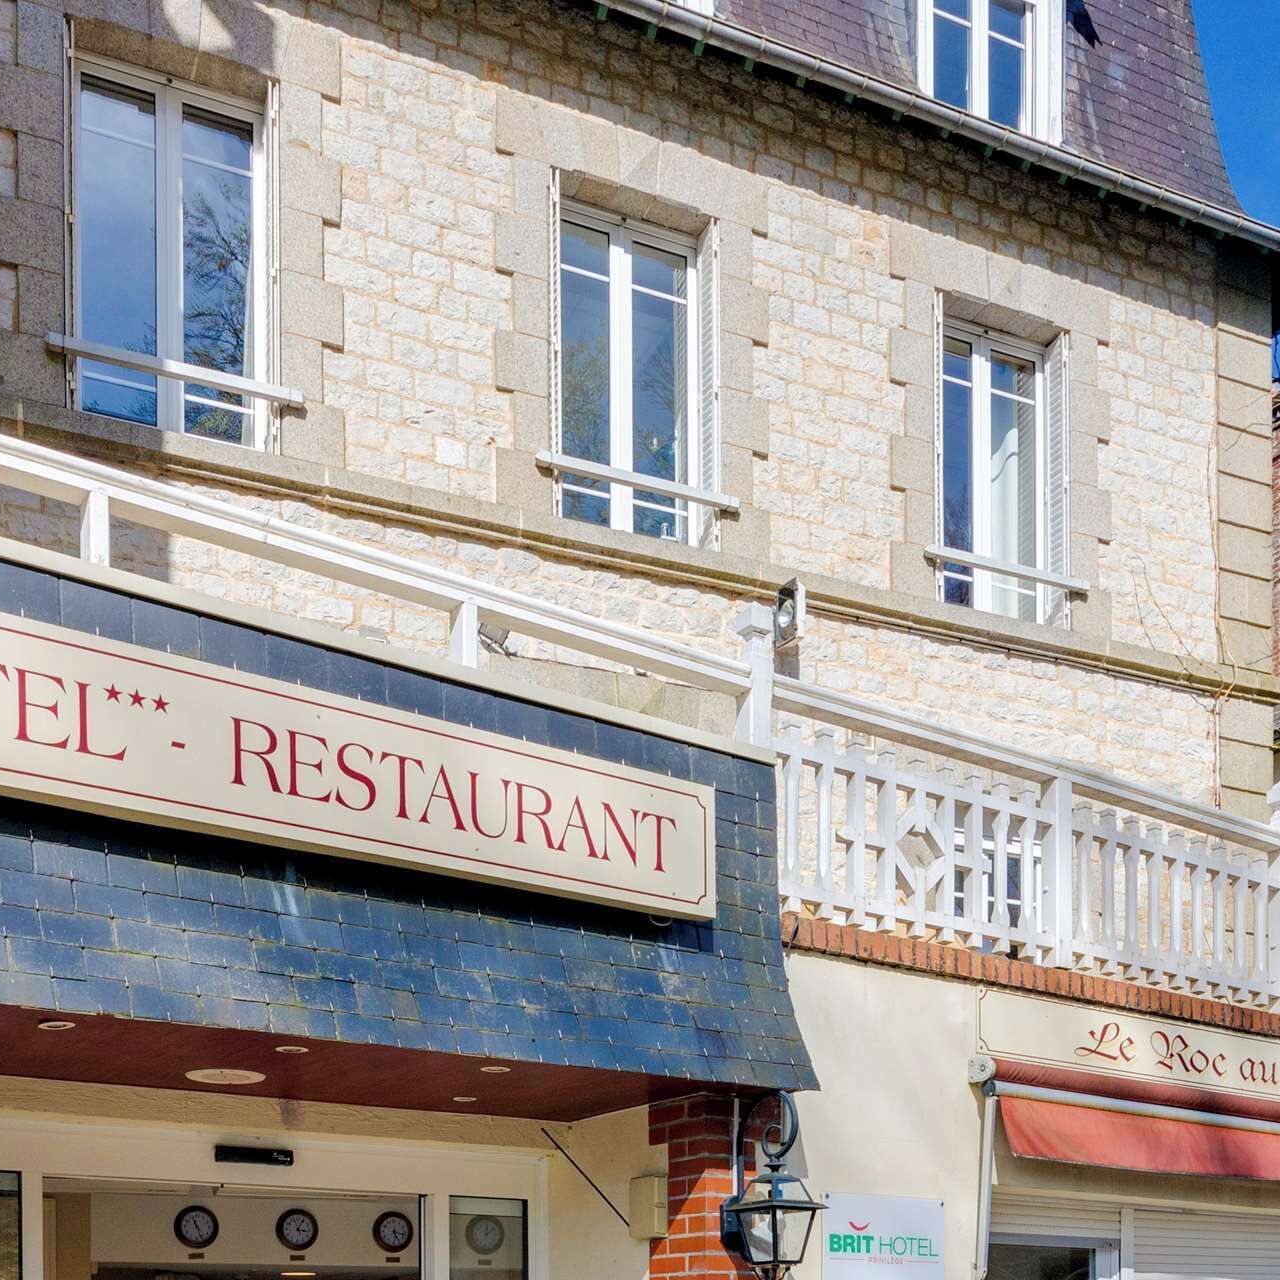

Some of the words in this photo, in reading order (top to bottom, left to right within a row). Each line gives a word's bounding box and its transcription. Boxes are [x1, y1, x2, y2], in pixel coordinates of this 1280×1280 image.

[229, 714, 677, 874] RESTAURANT
[1073, 1020, 1136, 1063] Le
[1149, 1029, 1228, 1078] Roc
[1239, 1058, 1280, 1087] au
[829, 1233, 874, 1254] BRIT
[879, 1236, 940, 1257] HOTEL
